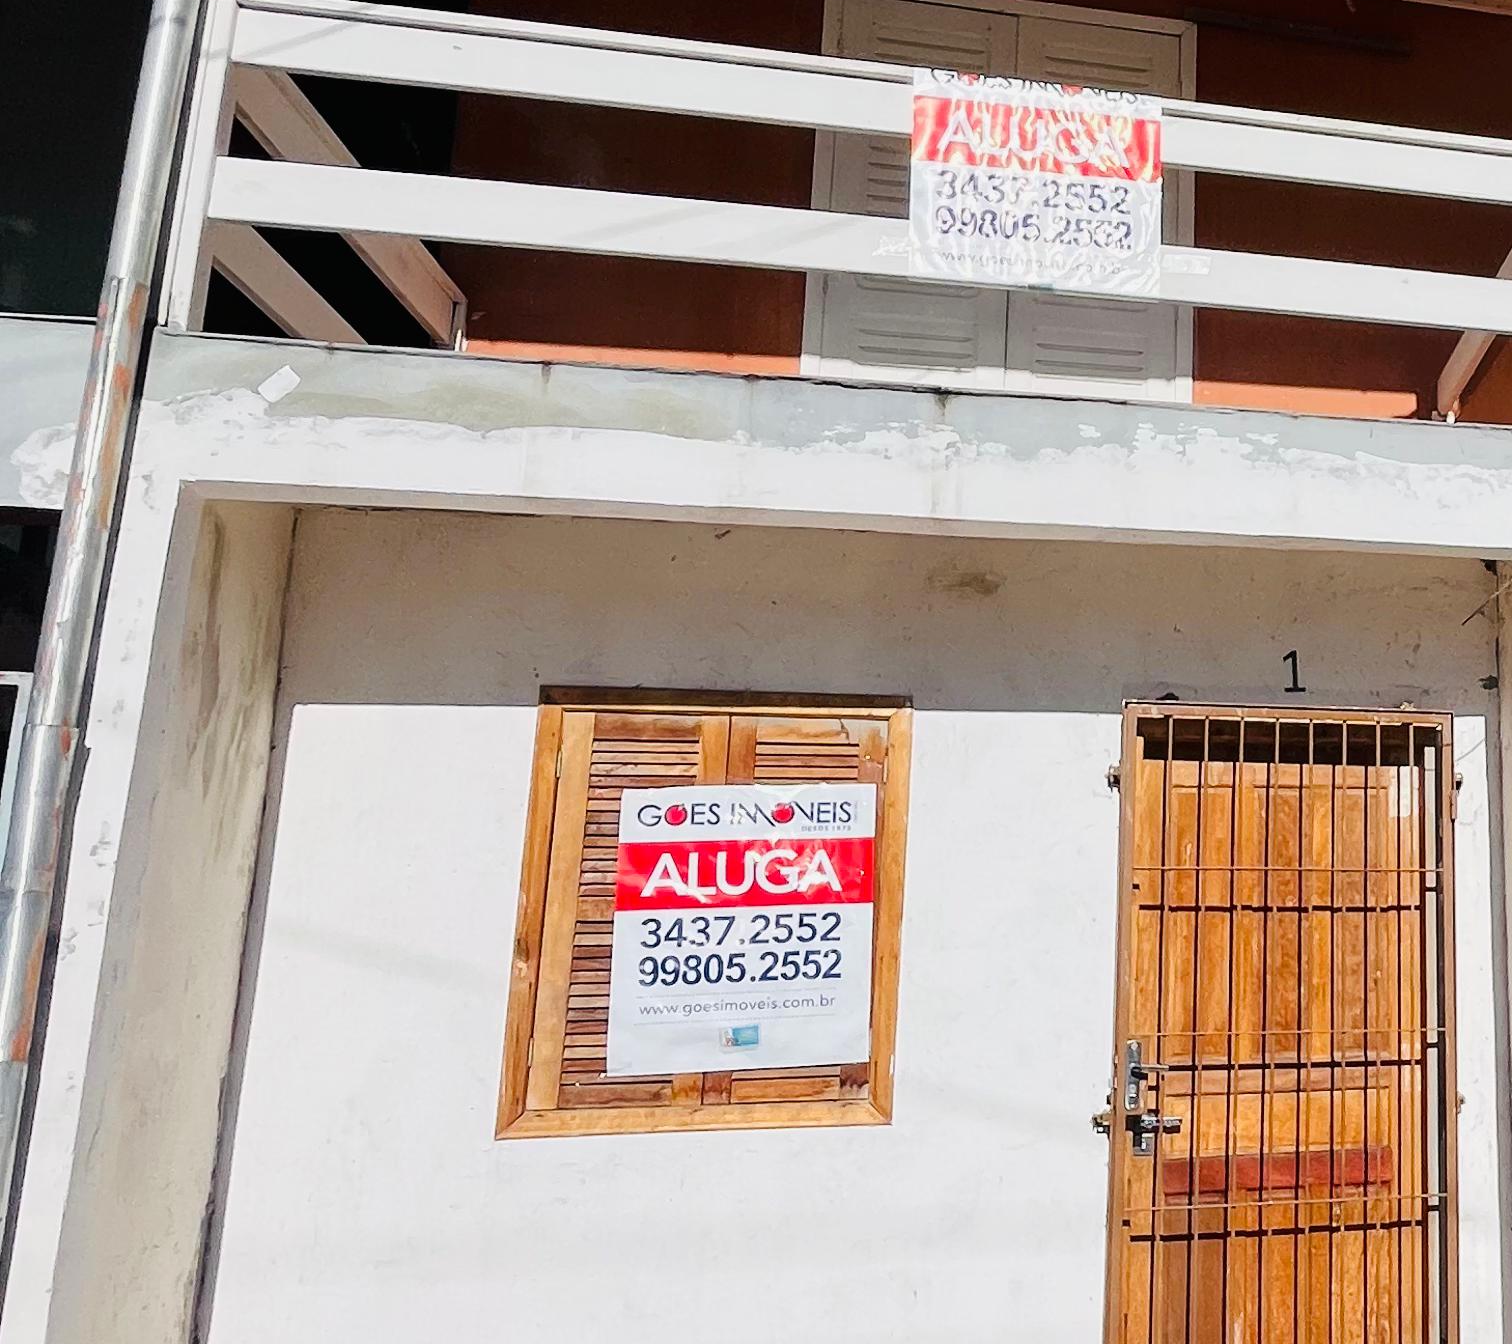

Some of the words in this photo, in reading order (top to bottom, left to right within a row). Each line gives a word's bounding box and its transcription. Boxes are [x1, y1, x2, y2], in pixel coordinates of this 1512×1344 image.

[937, 103, 1130, 168] ALUGA
[1282, 649, 1307, 693] 1
[637, 802, 721, 827] GOES
[640, 848, 843, 898] ALUGA
[640, 911, 842, 949] 3437.2552
[638, 949, 842, 987] 99805.2552
[639, 993, 836, 1017] www.goesimoveis.com.br
